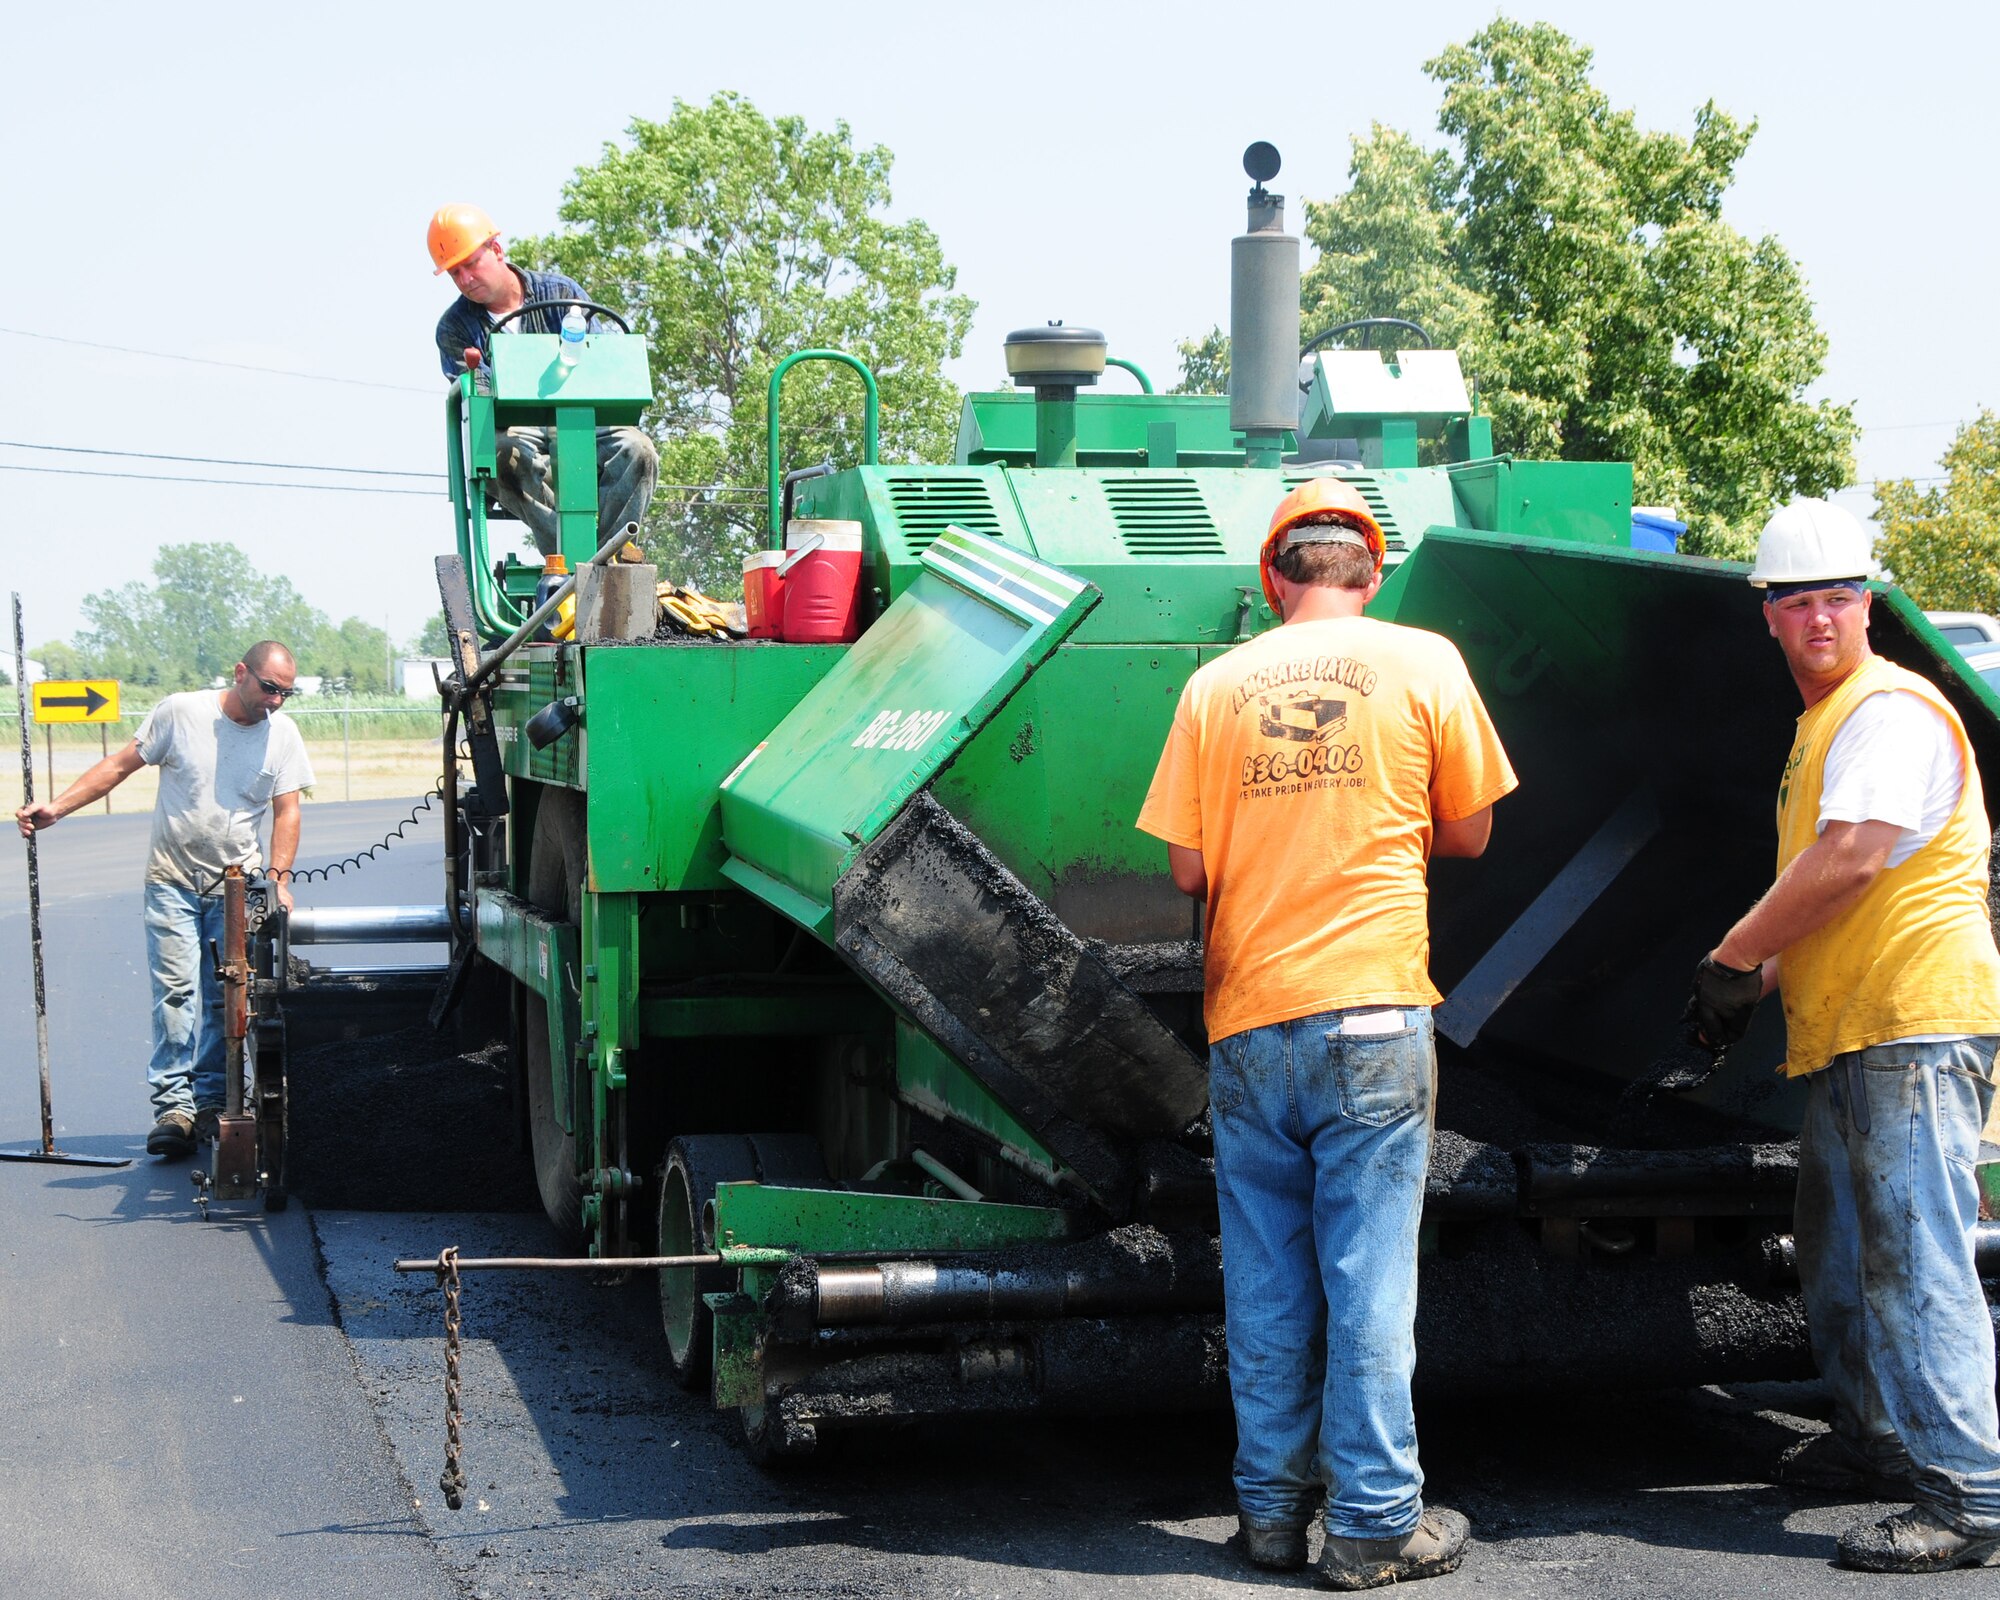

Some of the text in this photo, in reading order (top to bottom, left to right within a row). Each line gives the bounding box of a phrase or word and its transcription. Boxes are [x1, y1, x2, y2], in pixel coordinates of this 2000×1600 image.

[1314, 656, 1378, 697] PAVING
[1241, 744, 1363, 787] 636-0406
[1250, 787, 1273, 799] TAKE
[1275, 782, 1303, 797] PRIDE
[1304, 780, 1313, 792] IN
[1313, 777, 1342, 790] EVERY
[1343, 777, 1367, 788] JOB!
